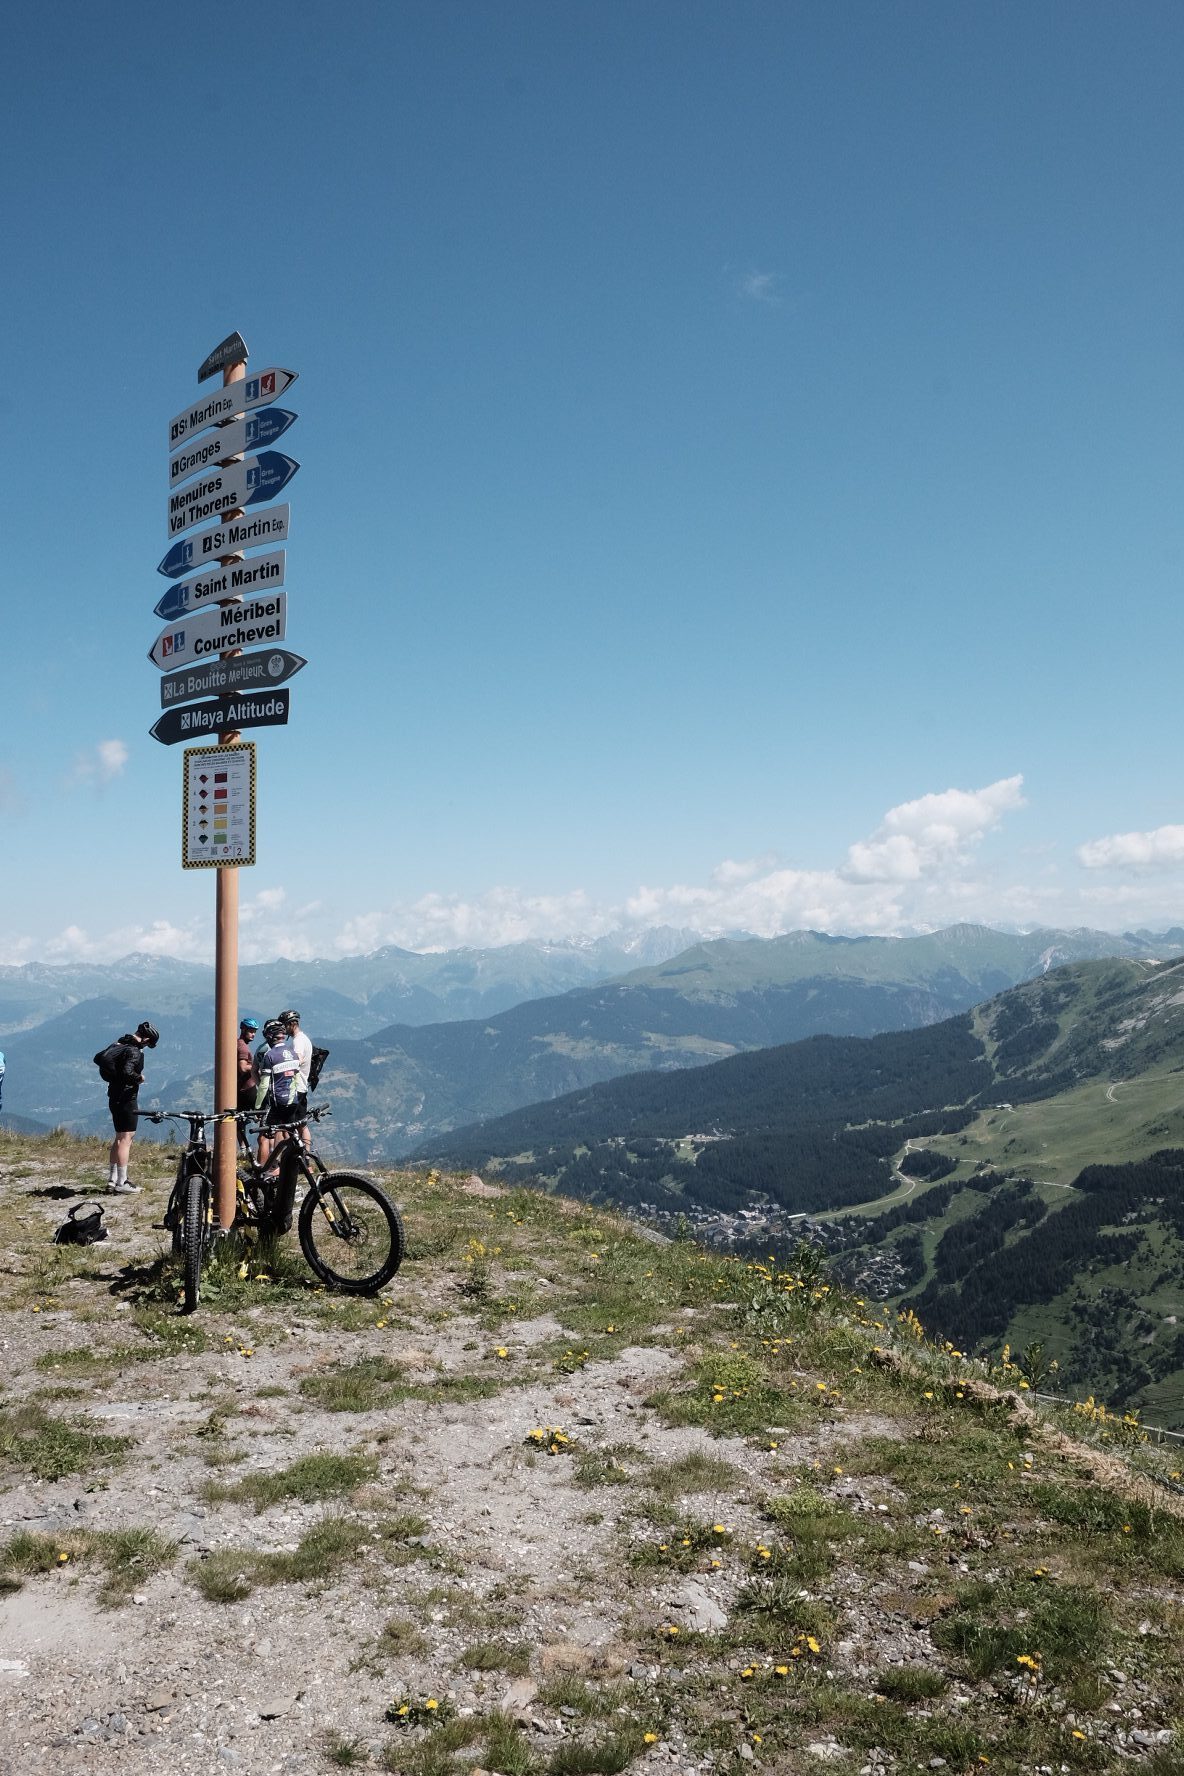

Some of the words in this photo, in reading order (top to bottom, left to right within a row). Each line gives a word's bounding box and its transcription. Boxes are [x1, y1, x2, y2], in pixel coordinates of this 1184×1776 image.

[190, 401, 221, 428] Martin
[180, 441, 221, 471] Granges
[170, 477, 222, 513] Menuires
[170, 512, 186, 532] Val
[189, 492, 237, 522] Thorens
[229, 519, 271, 544] Martin
[195, 575, 227, 599] Saint
[231, 562, 280, 587] Martin
[220, 598, 280, 627] Méribel
[194, 620, 280, 655] Courchevel
[173, 681, 185, 697] La
[187, 670, 227, 693] Bouitte
[191, 710, 224, 729] Maya
[227, 699, 285, 722] Altitude
[236, 847, 242, 856] 2
